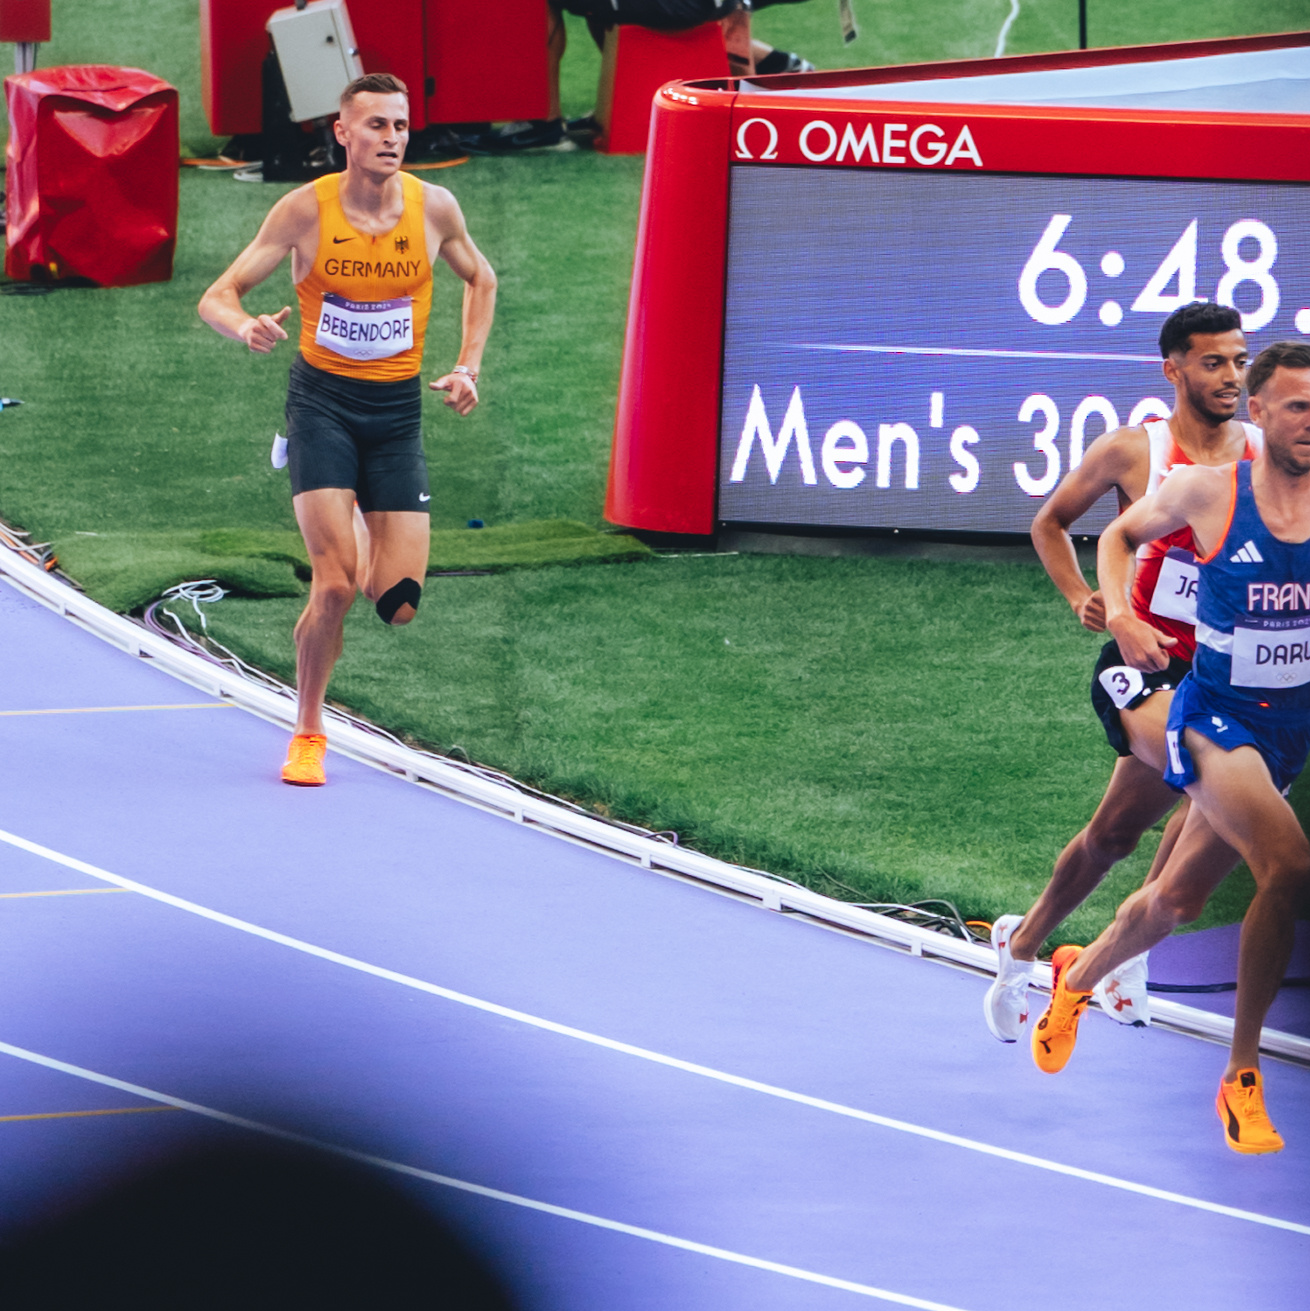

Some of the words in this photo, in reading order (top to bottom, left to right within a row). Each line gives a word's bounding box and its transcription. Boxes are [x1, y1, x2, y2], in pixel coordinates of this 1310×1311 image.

[799, 120, 983, 167] OMEGA
[324, 258, 422, 278] GERMANY
[320, 313, 410, 342] BEBENDORF
[730, 383, 981, 494] Men's
[1263, 620, 1290, 628] PARIS
[1112, 671, 1131, 695] 3
